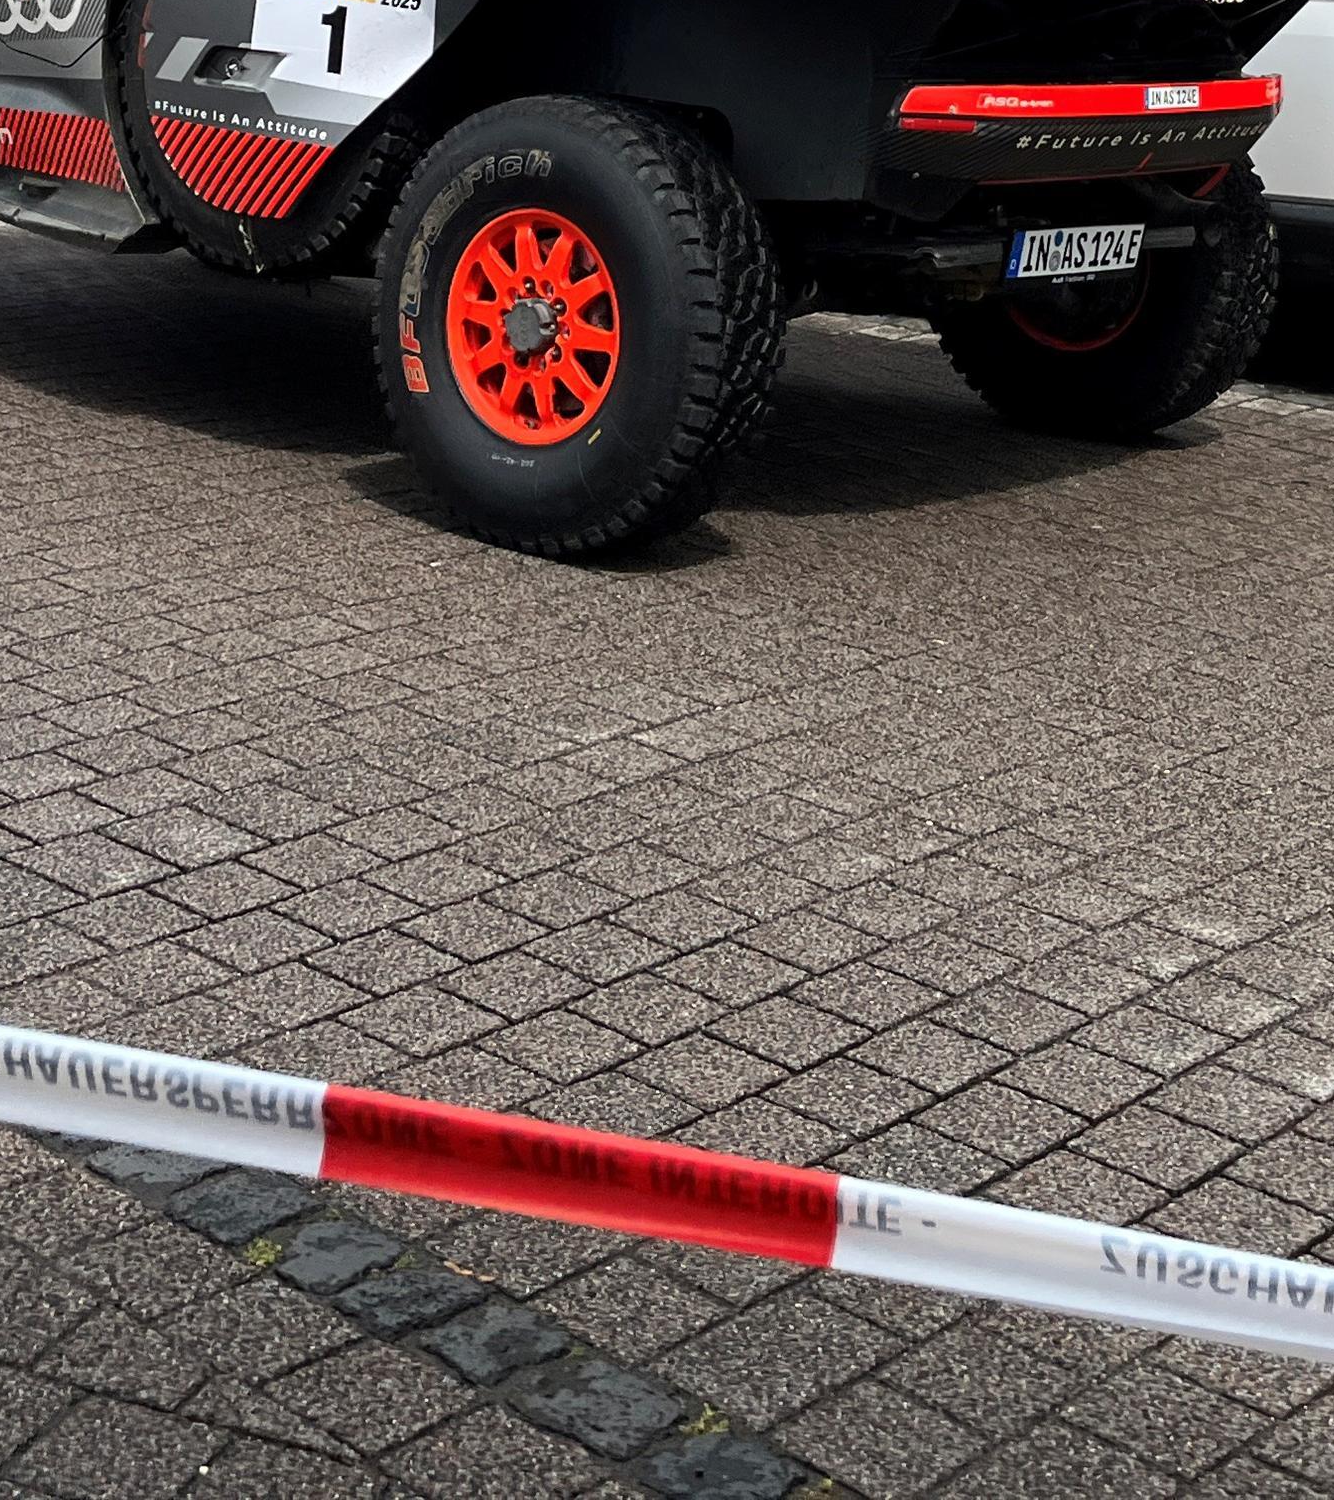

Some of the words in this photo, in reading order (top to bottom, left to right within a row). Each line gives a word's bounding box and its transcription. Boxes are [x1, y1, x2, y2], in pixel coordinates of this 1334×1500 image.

[321, 5, 347, 74] 1
[213, 110, 226, 123] Is
[231, 113, 250, 127] An
[256, 117, 328, 141] Attitude
[1017, 133, 1123, 150] #Future
[1130, 131, 1150, 145] Is
[1158, 128, 1185, 144] An
[1023, 234, 1052, 272] IN
[1061, 232, 1088, 269] AS
[1088, 229, 1142, 267] 124E
